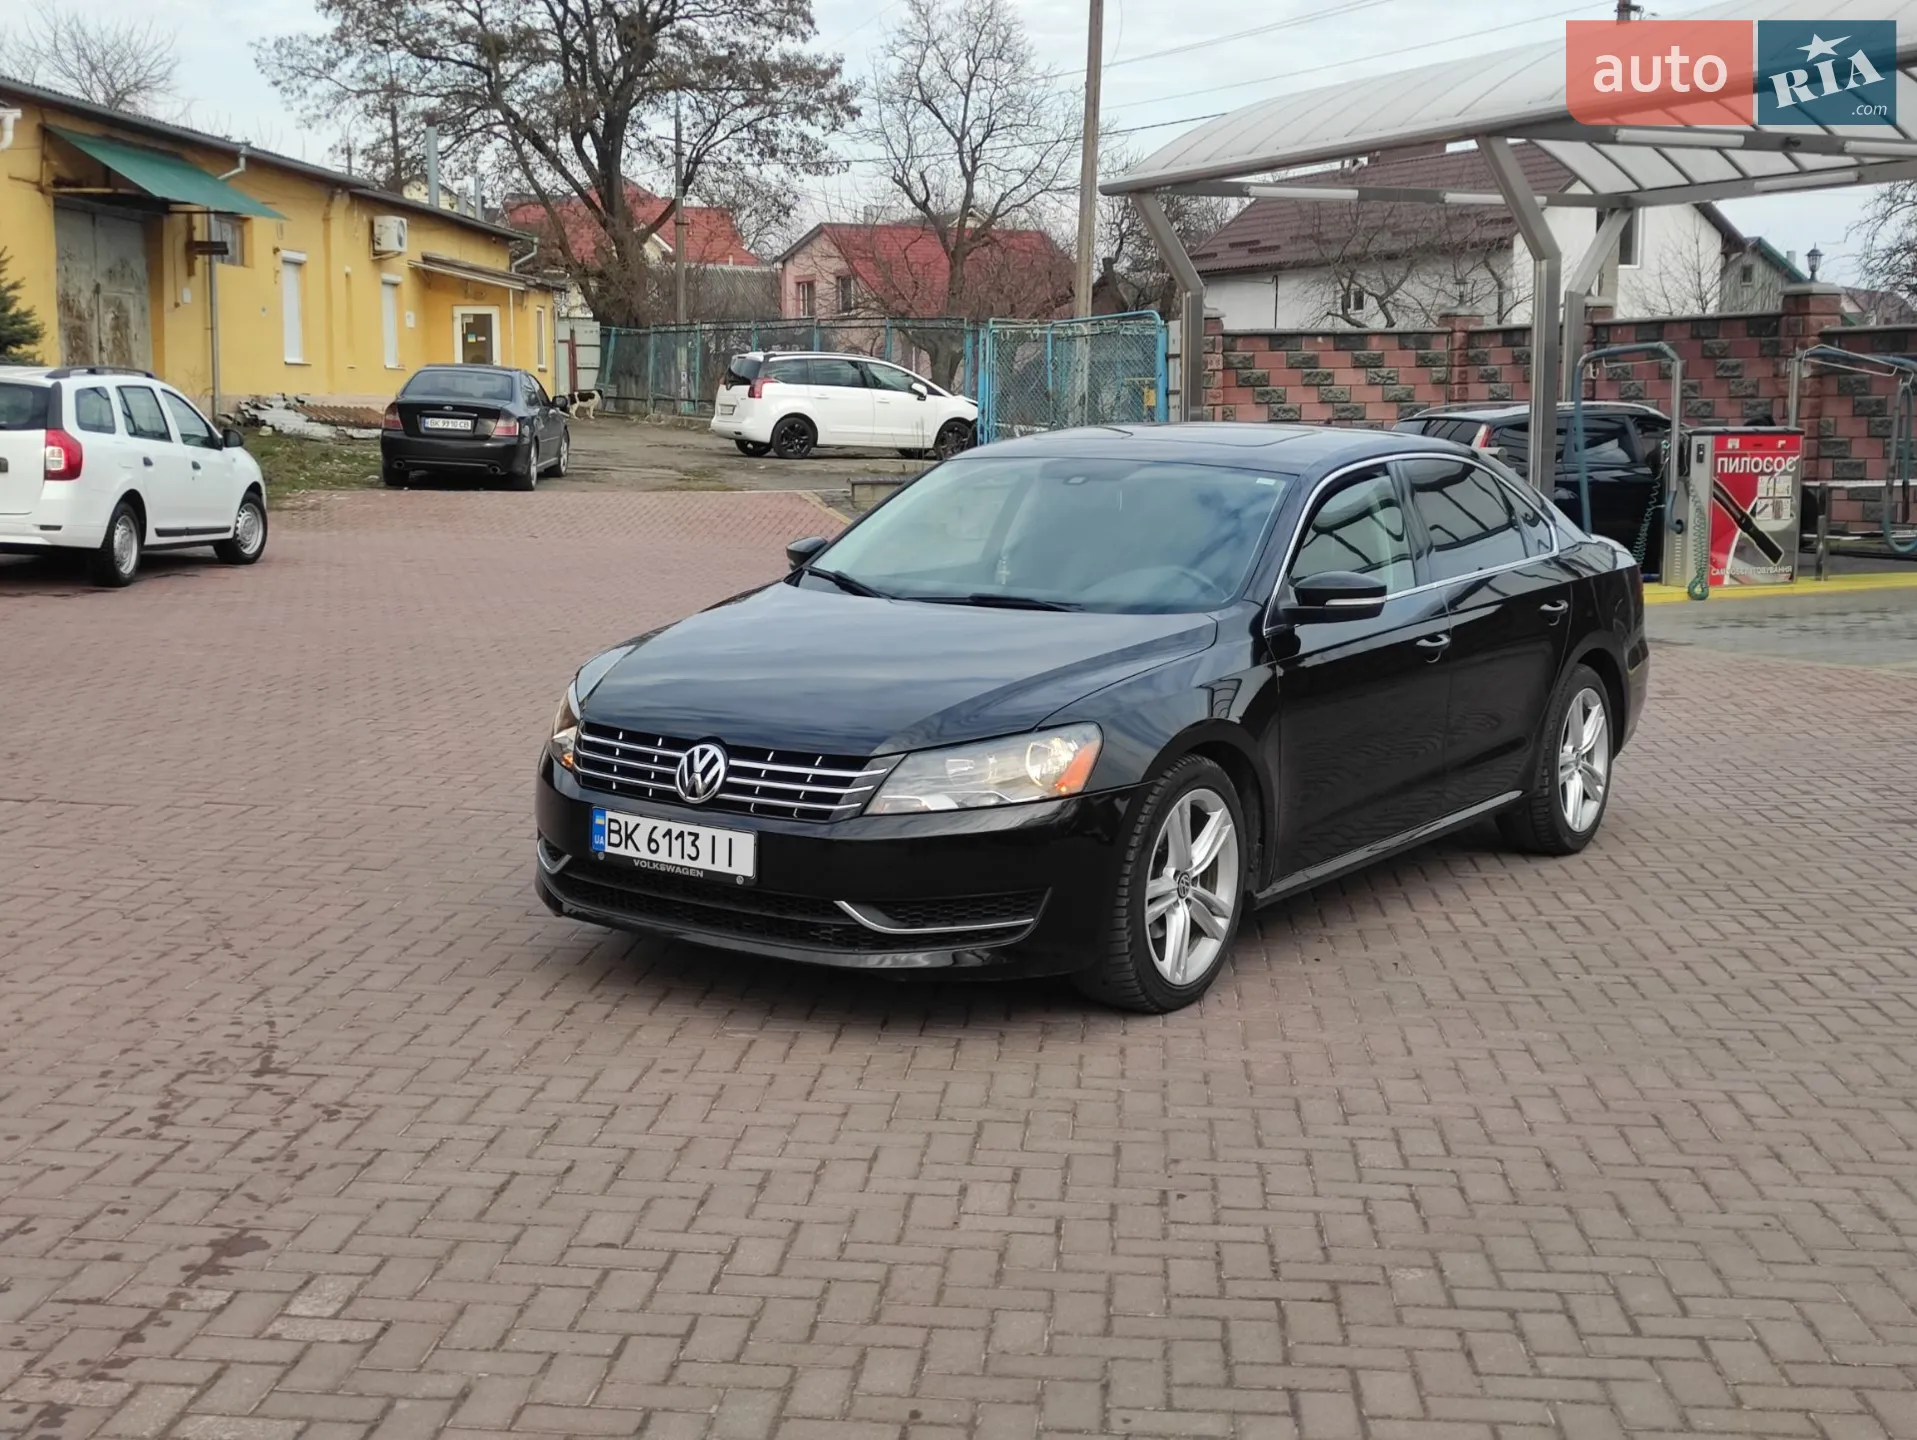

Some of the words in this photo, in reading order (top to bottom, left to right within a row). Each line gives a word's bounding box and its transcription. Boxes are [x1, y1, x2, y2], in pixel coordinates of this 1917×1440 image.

[1717, 456, 1797, 473] ПИЛОСОС
[594, 835, 605, 845] UA
[607, 818, 641, 853] BK
[647, 826, 700, 861] 6113
[711, 835, 733, 868] II
[633, 859, 704, 878] VOLKSWAGEN
